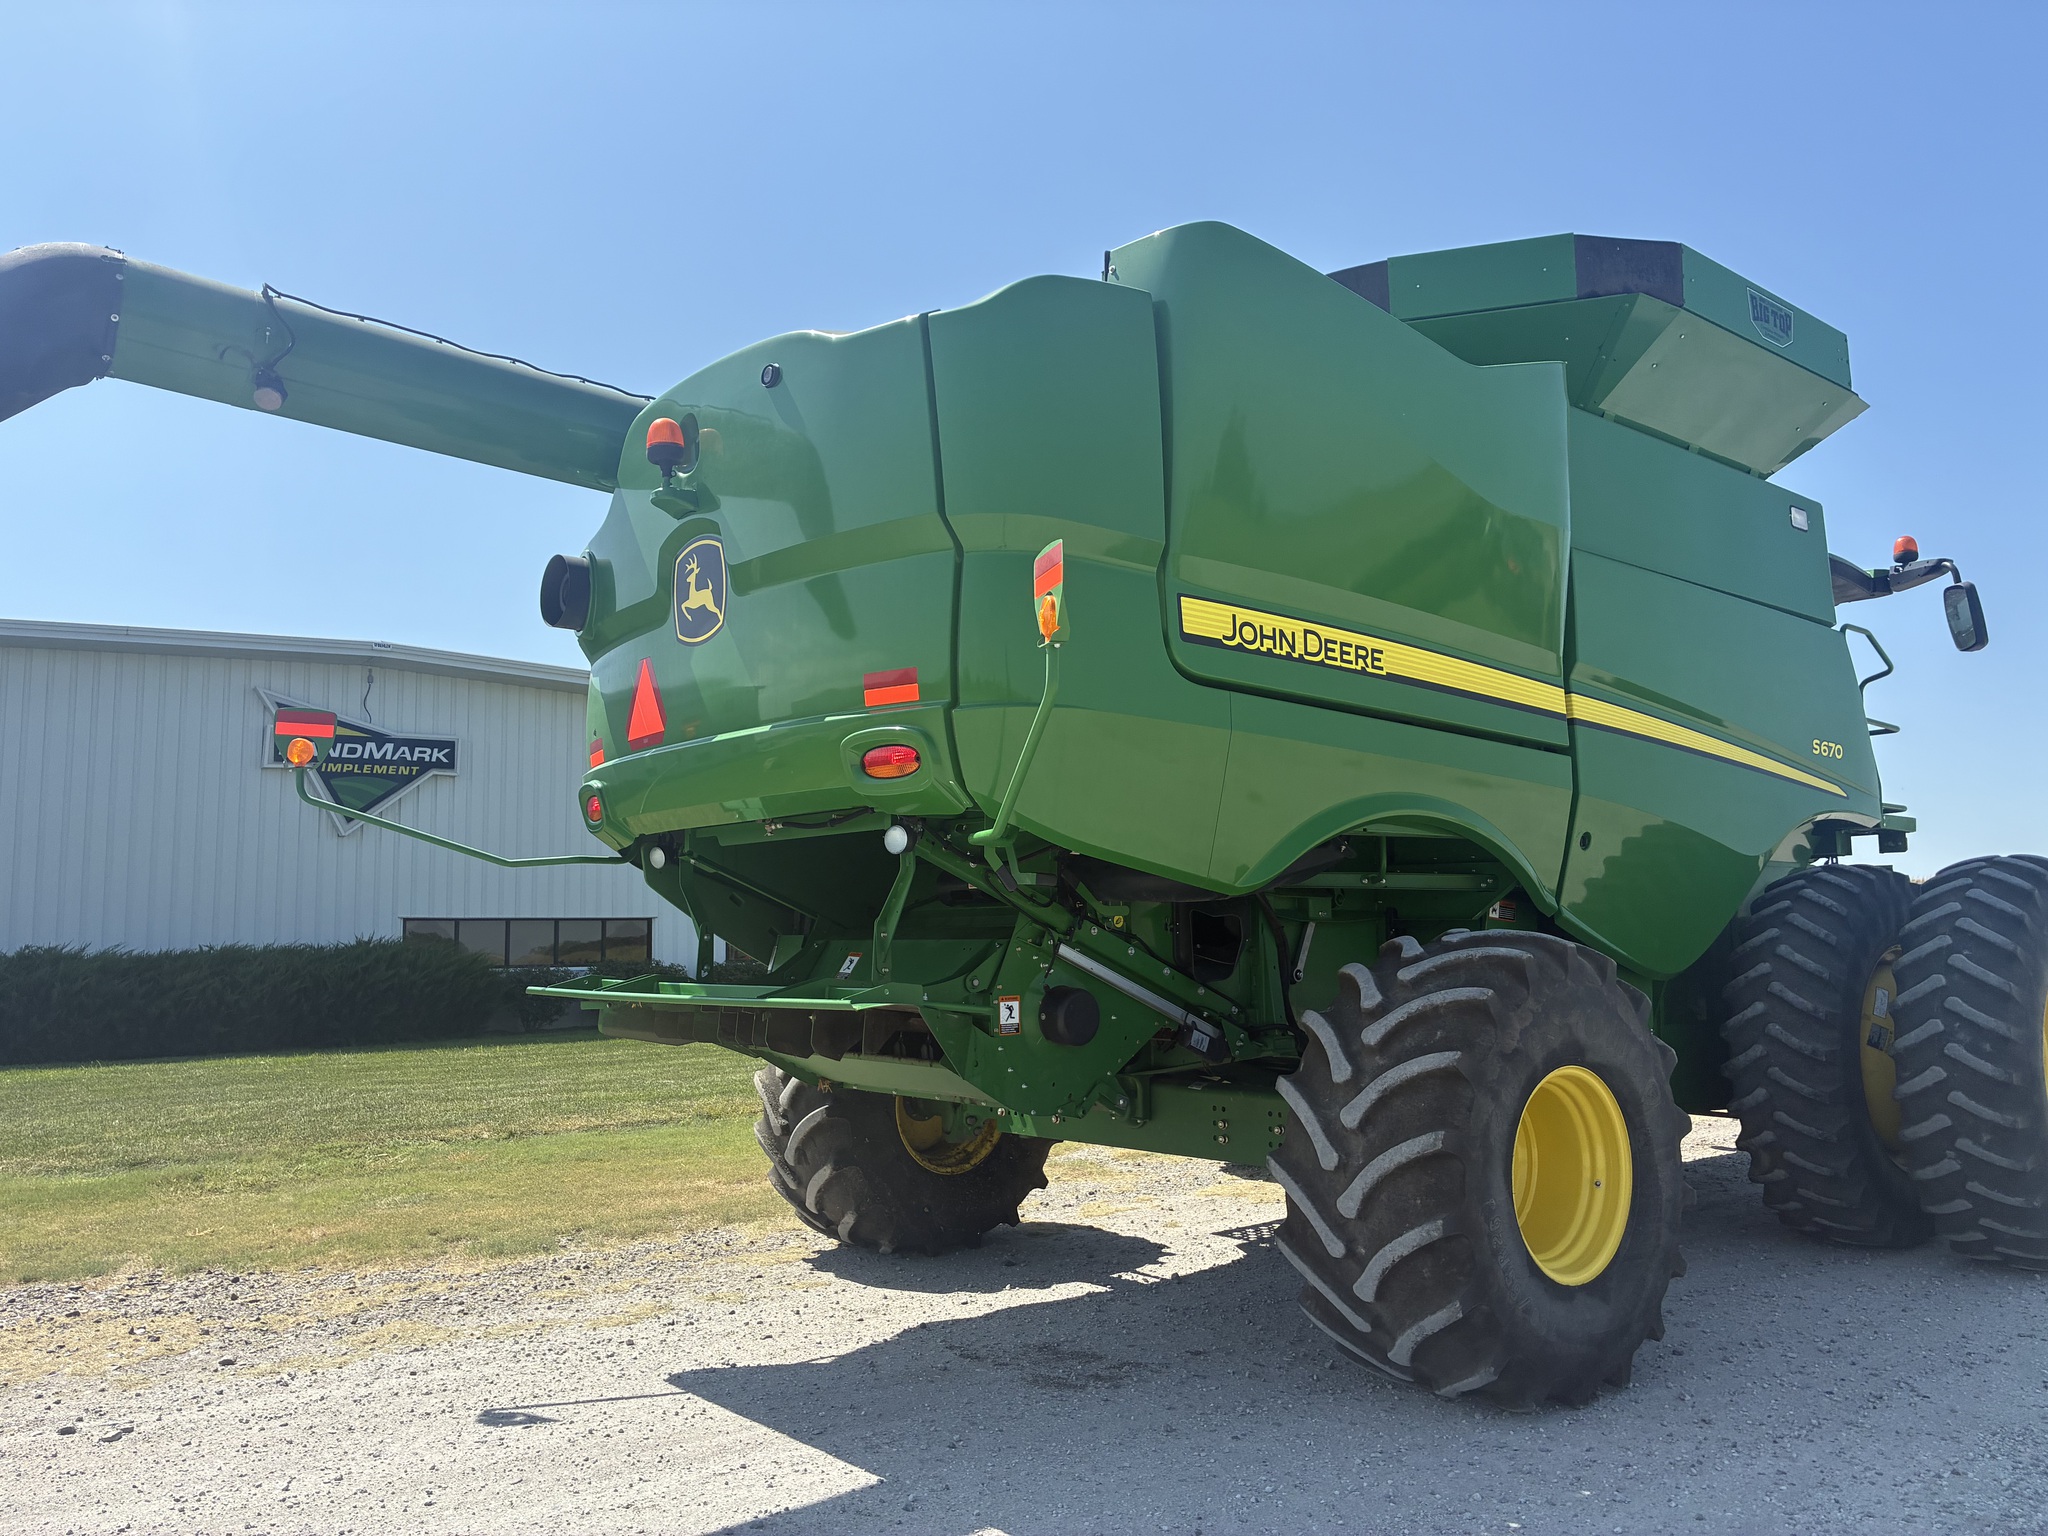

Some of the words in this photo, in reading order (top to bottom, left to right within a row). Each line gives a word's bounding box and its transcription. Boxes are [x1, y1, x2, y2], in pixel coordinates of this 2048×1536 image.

[1749, 293, 1770, 324] BIG
[1770, 308, 1791, 338] TOP
[1222, 614, 1296, 654] JOHN
[1303, 628, 1385, 671] DEERE
[313, 741, 451, 763] NDMARK
[1812, 739, 1843, 760] S670
[321, 763, 420, 775] IMPLEMENT
